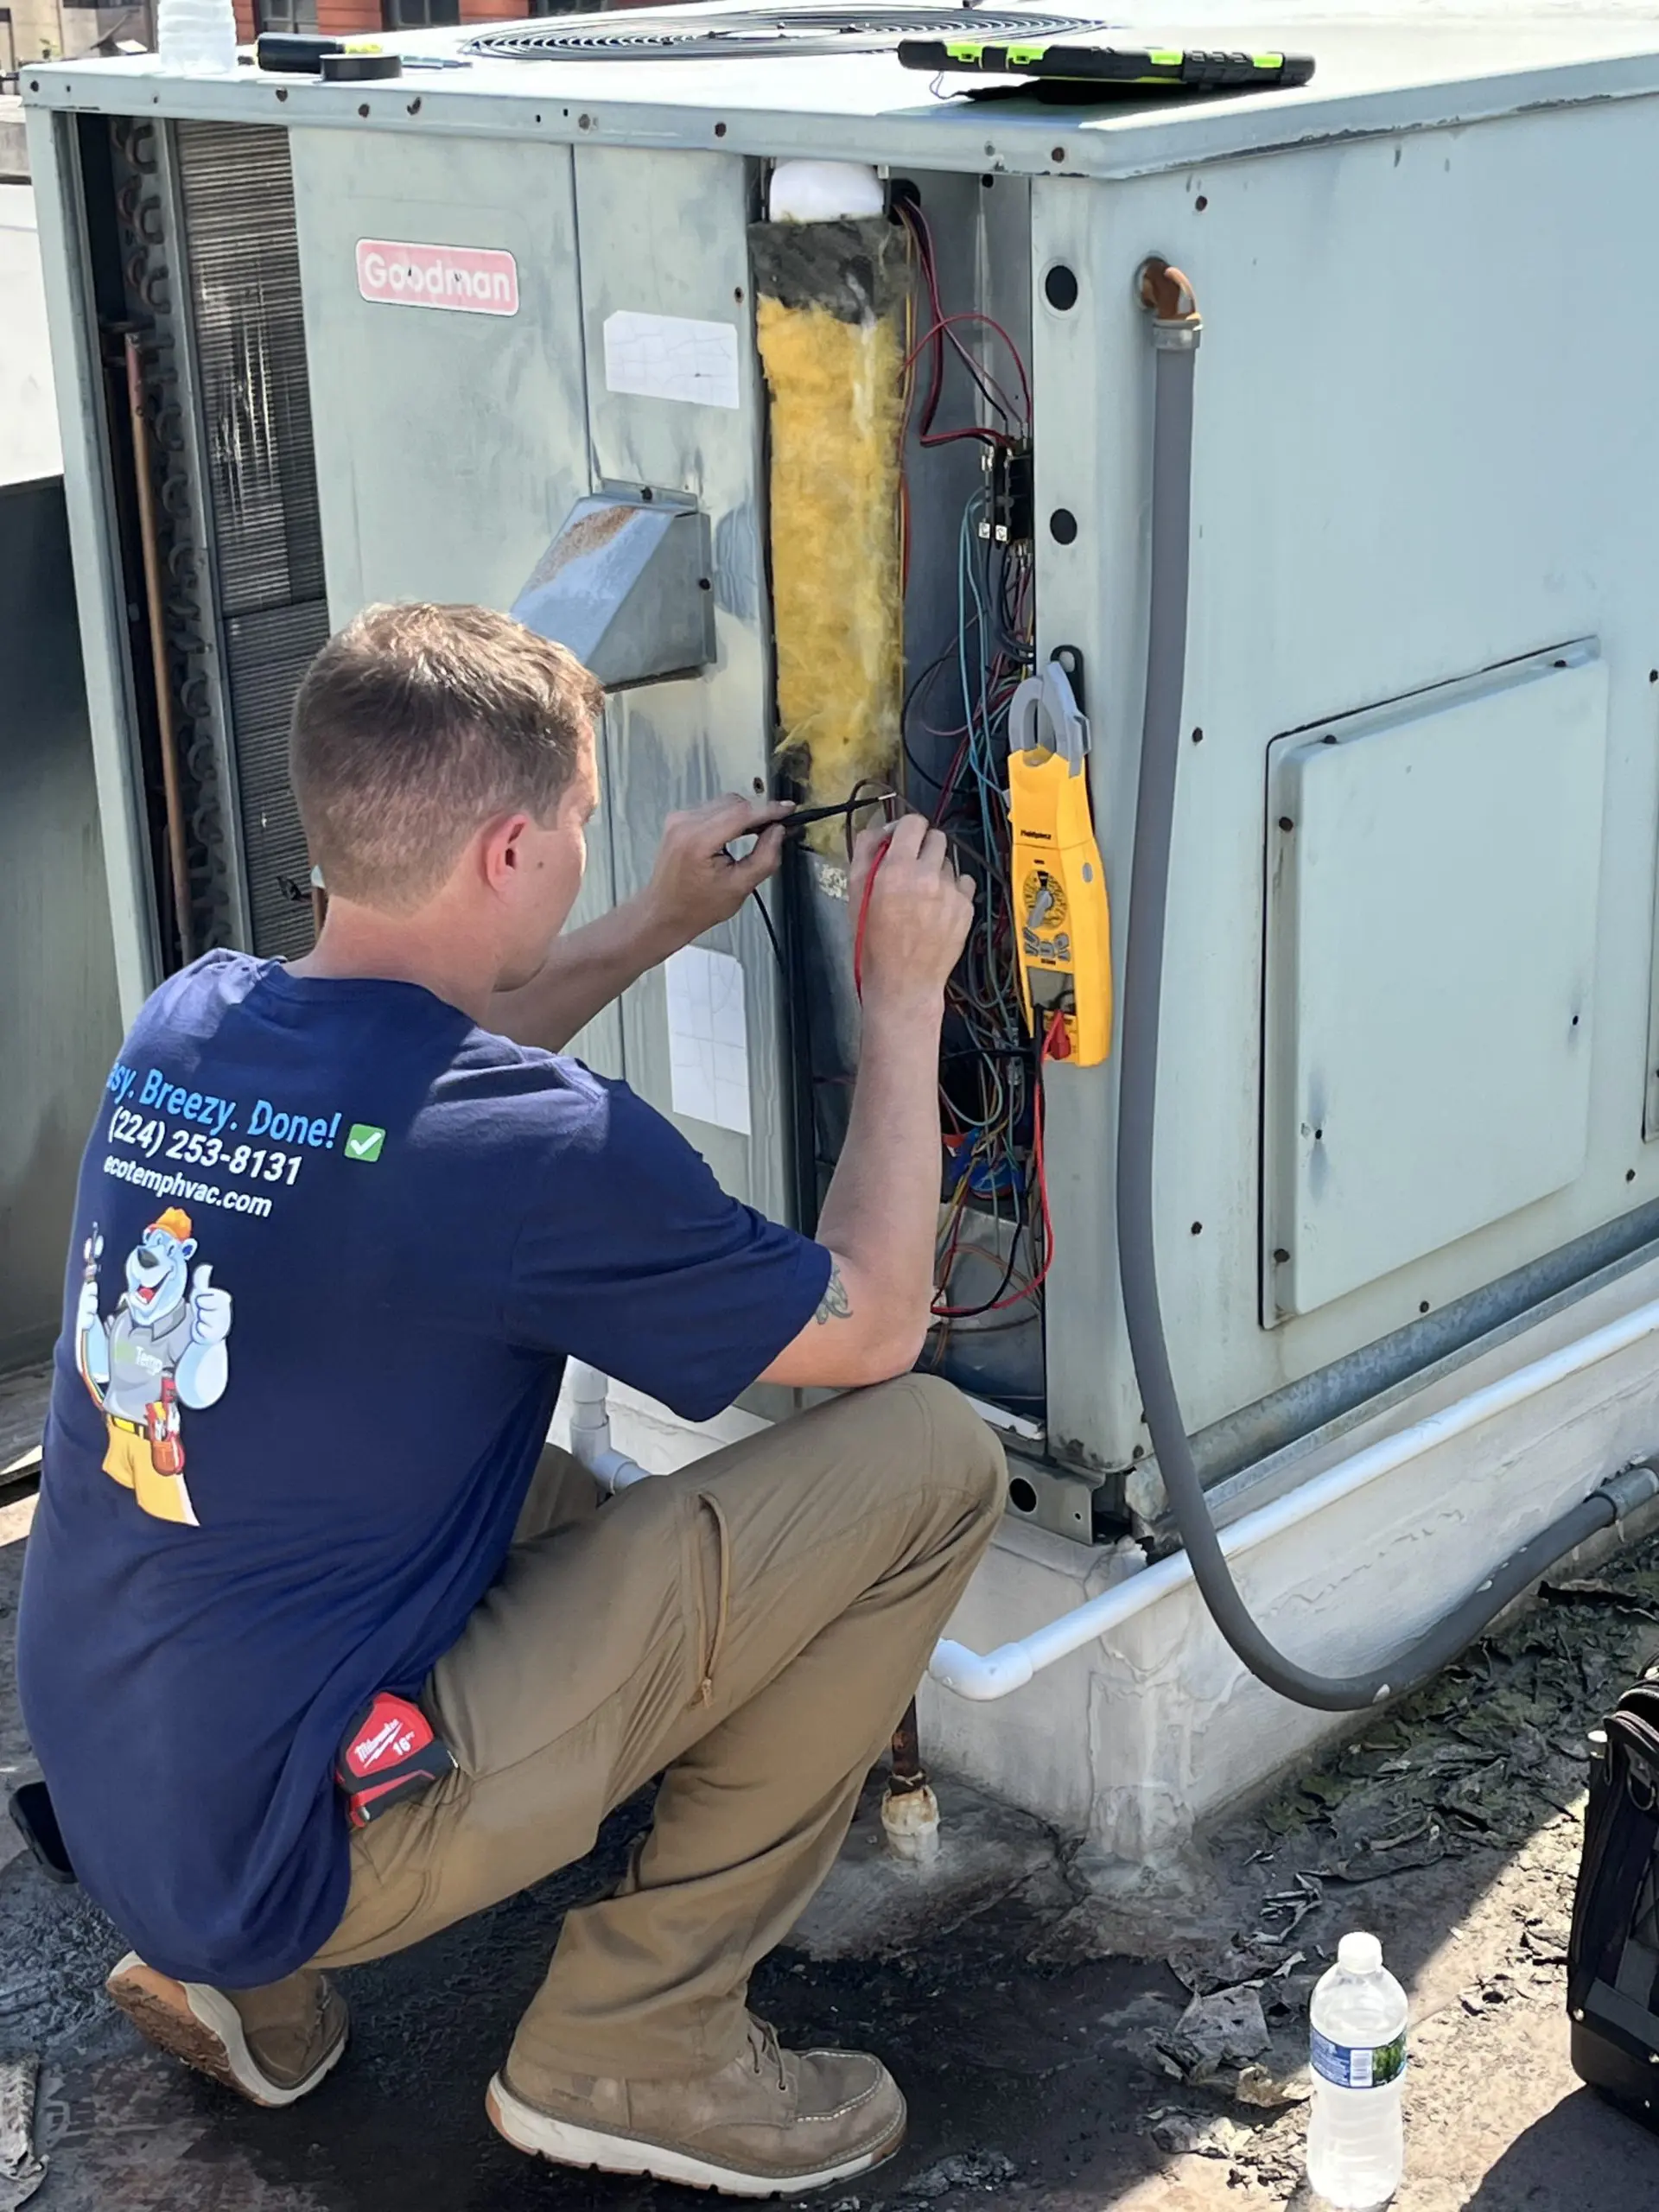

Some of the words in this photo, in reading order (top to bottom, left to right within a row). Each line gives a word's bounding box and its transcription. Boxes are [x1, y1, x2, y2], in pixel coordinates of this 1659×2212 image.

[365, 252, 511, 302] Goodman
[139, 1069, 238, 1136] Breezy.
[247, 1100, 342, 1148] Done!
[108, 1105, 165, 1158] (224)
[165, 1130, 302, 1185] 253-8131
[103, 1154, 272, 1217] ecotemphvac.com
